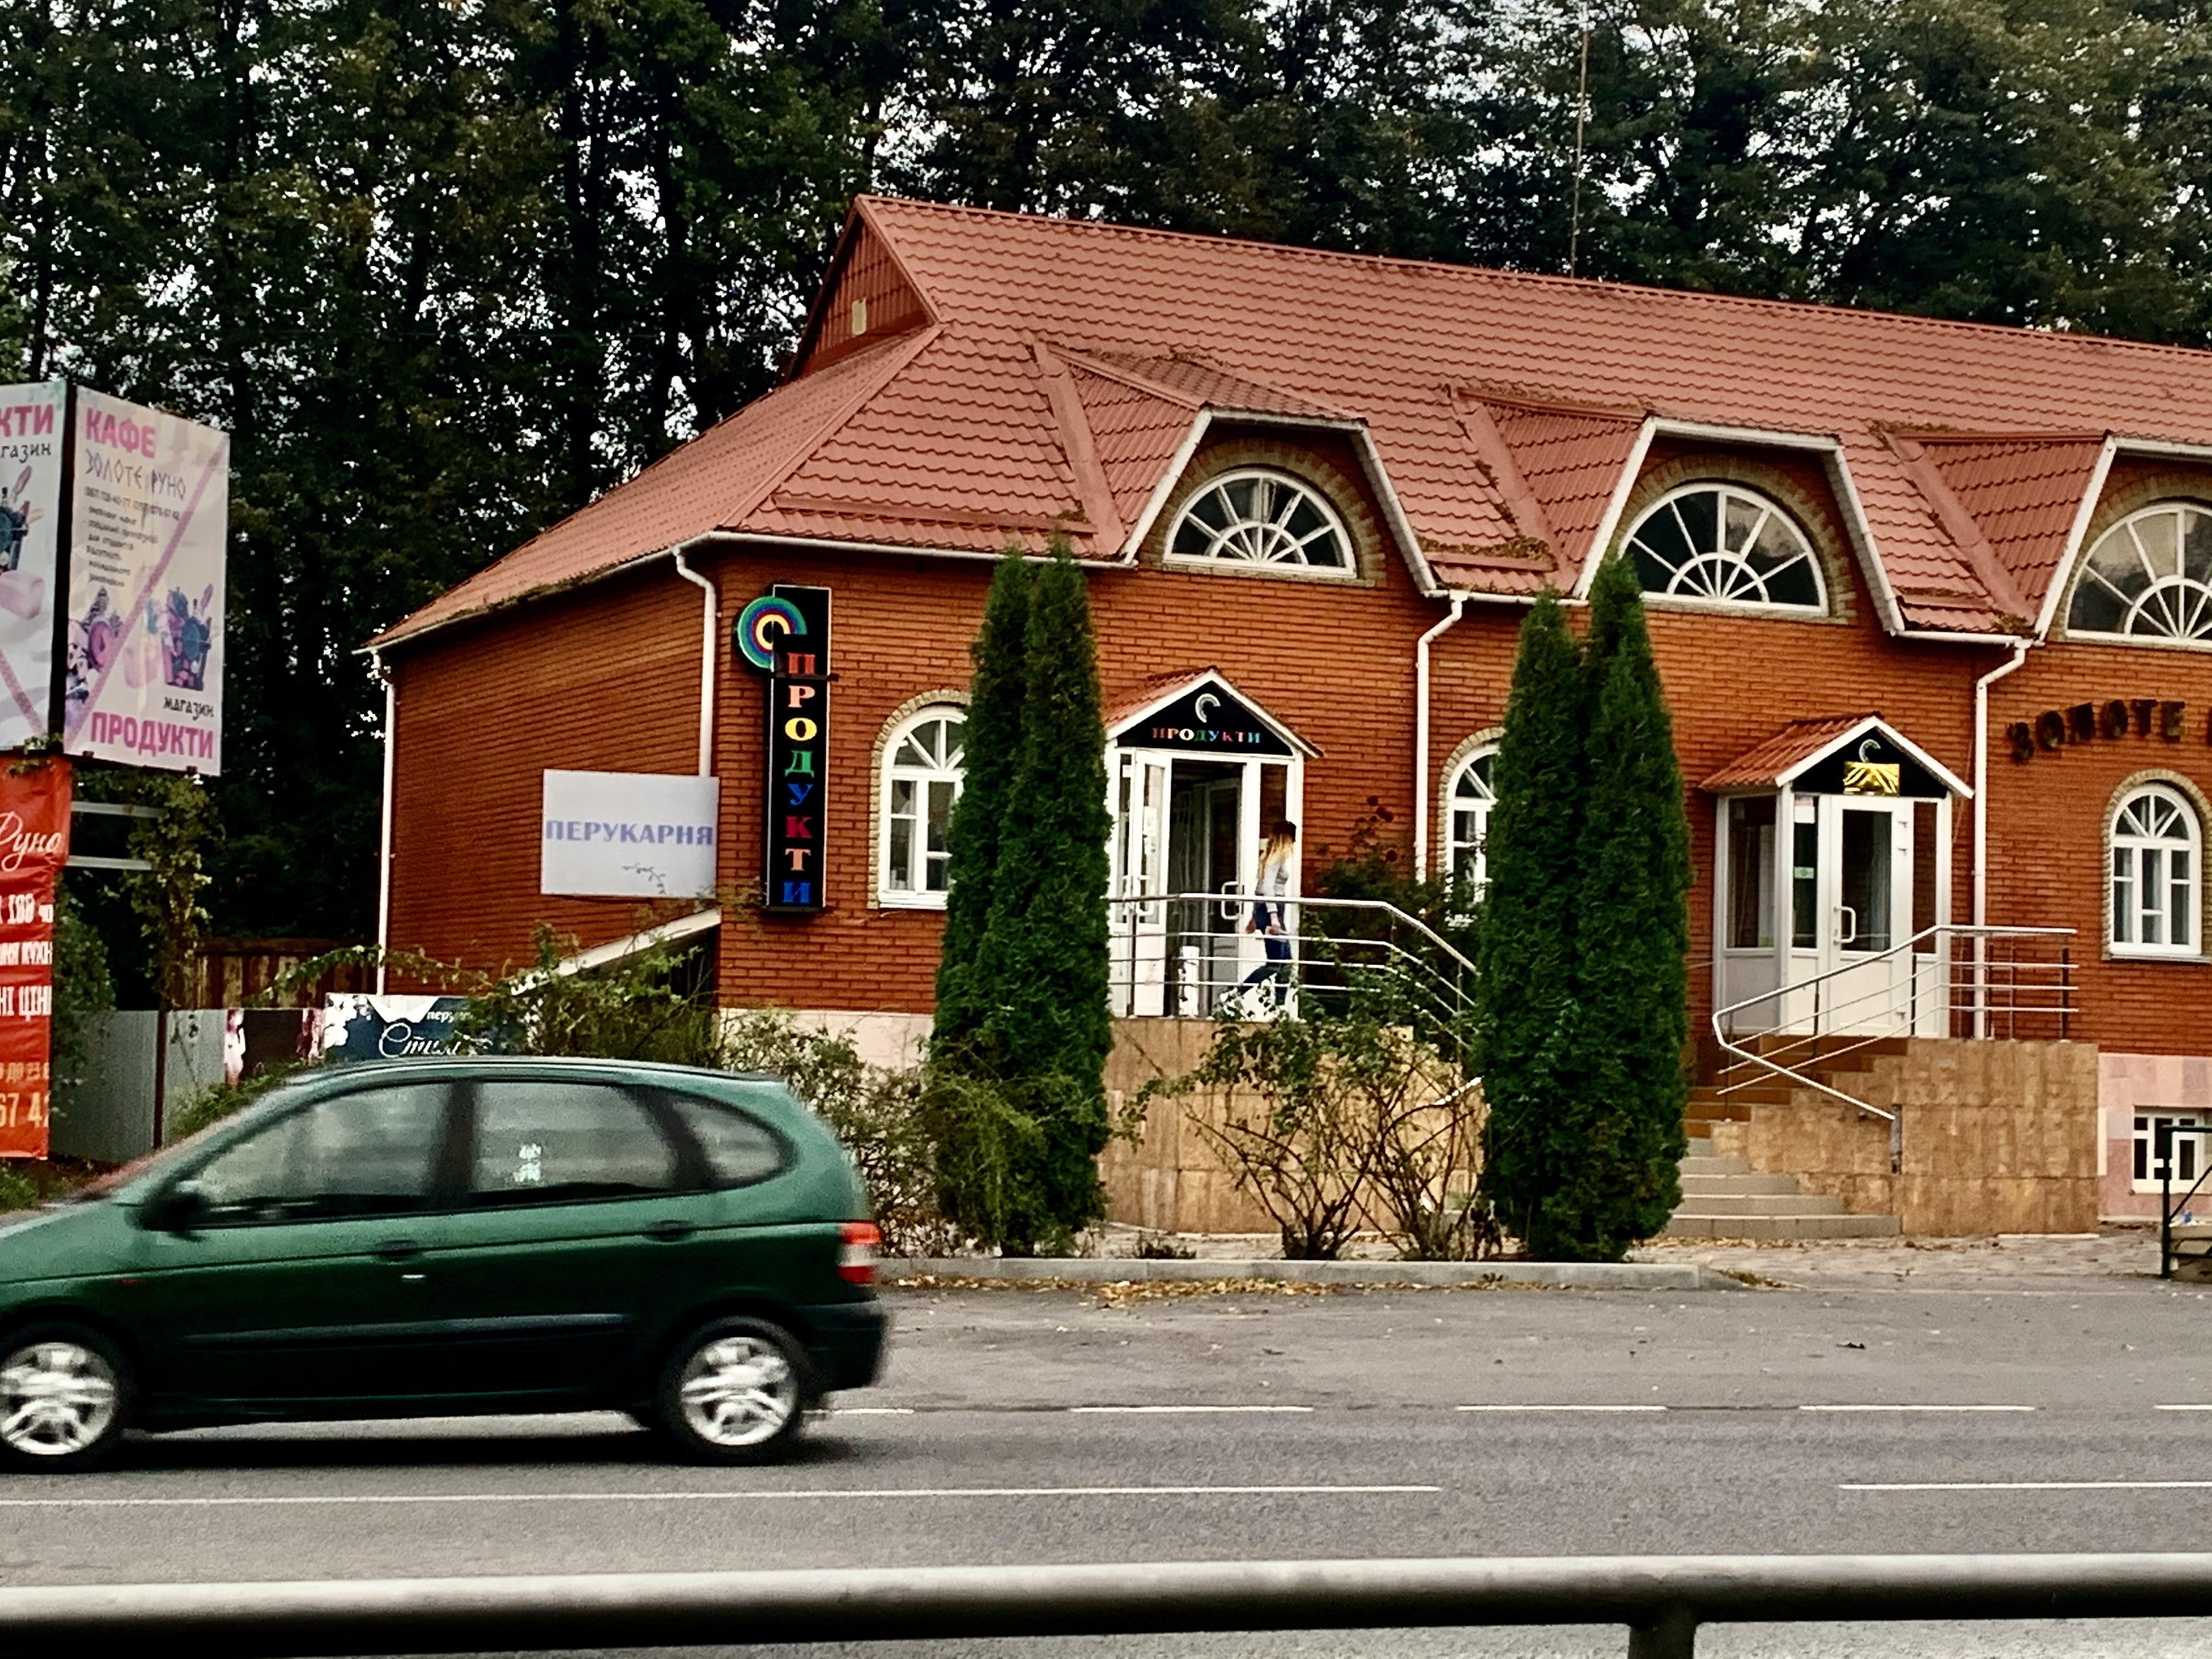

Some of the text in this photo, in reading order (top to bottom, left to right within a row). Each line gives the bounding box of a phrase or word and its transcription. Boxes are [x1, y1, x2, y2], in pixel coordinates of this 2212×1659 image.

[86, 408, 156, 459] КАФЕ
[85, 448, 186, 501] ЗОЛОТЕ РУНО
[163, 696, 214, 721] магазин
[91, 712, 213, 759] ПРОДУКТИ
[1152, 728, 1261, 744] ПРОДУКТИ
[783, 652, 817, 904] ПРОДУКТИ
[545, 820, 713, 845] ПЕРУКАРНЯ
